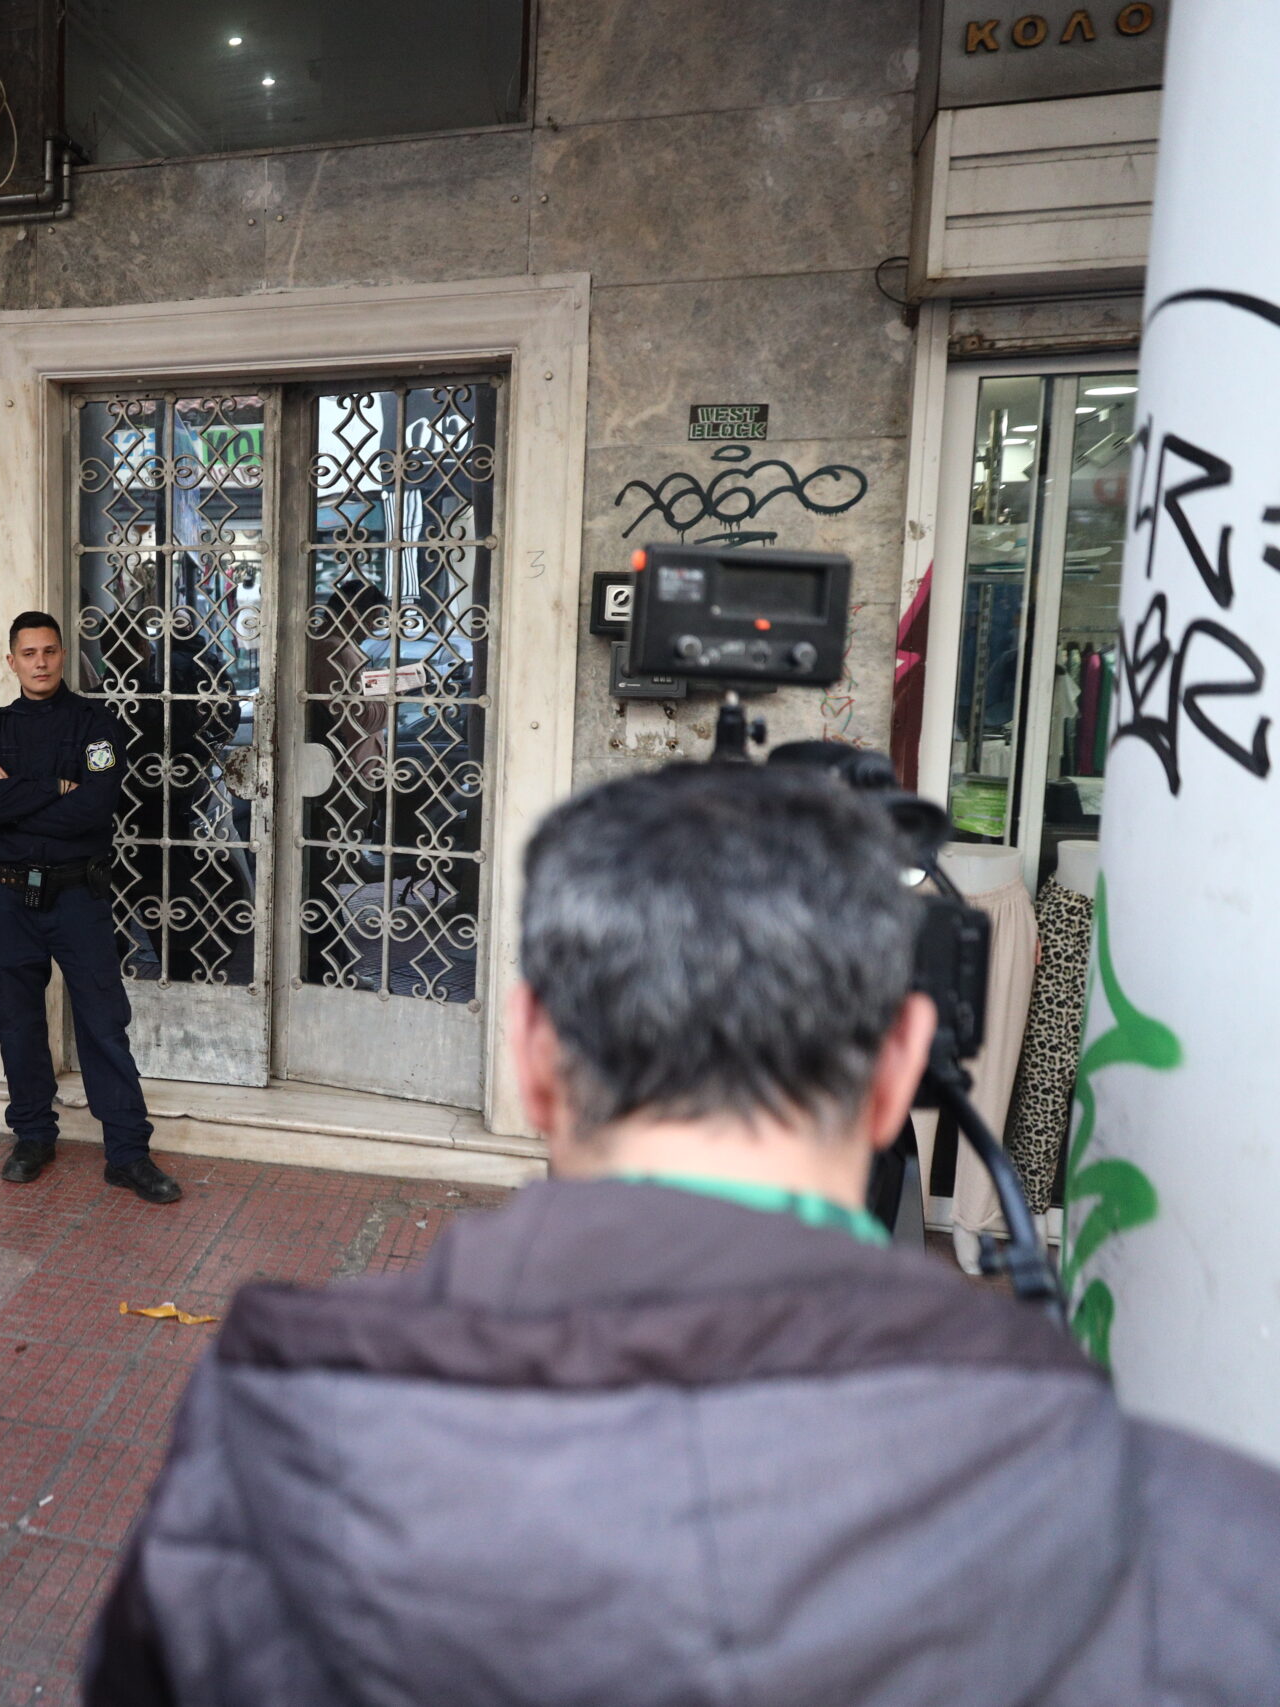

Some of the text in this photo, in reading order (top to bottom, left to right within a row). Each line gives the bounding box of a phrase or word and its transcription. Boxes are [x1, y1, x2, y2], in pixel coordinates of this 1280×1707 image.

[697, 407, 760, 423] WEST
[689, 422, 767, 439] BLOCK
[524, 550, 546, 579] 3
